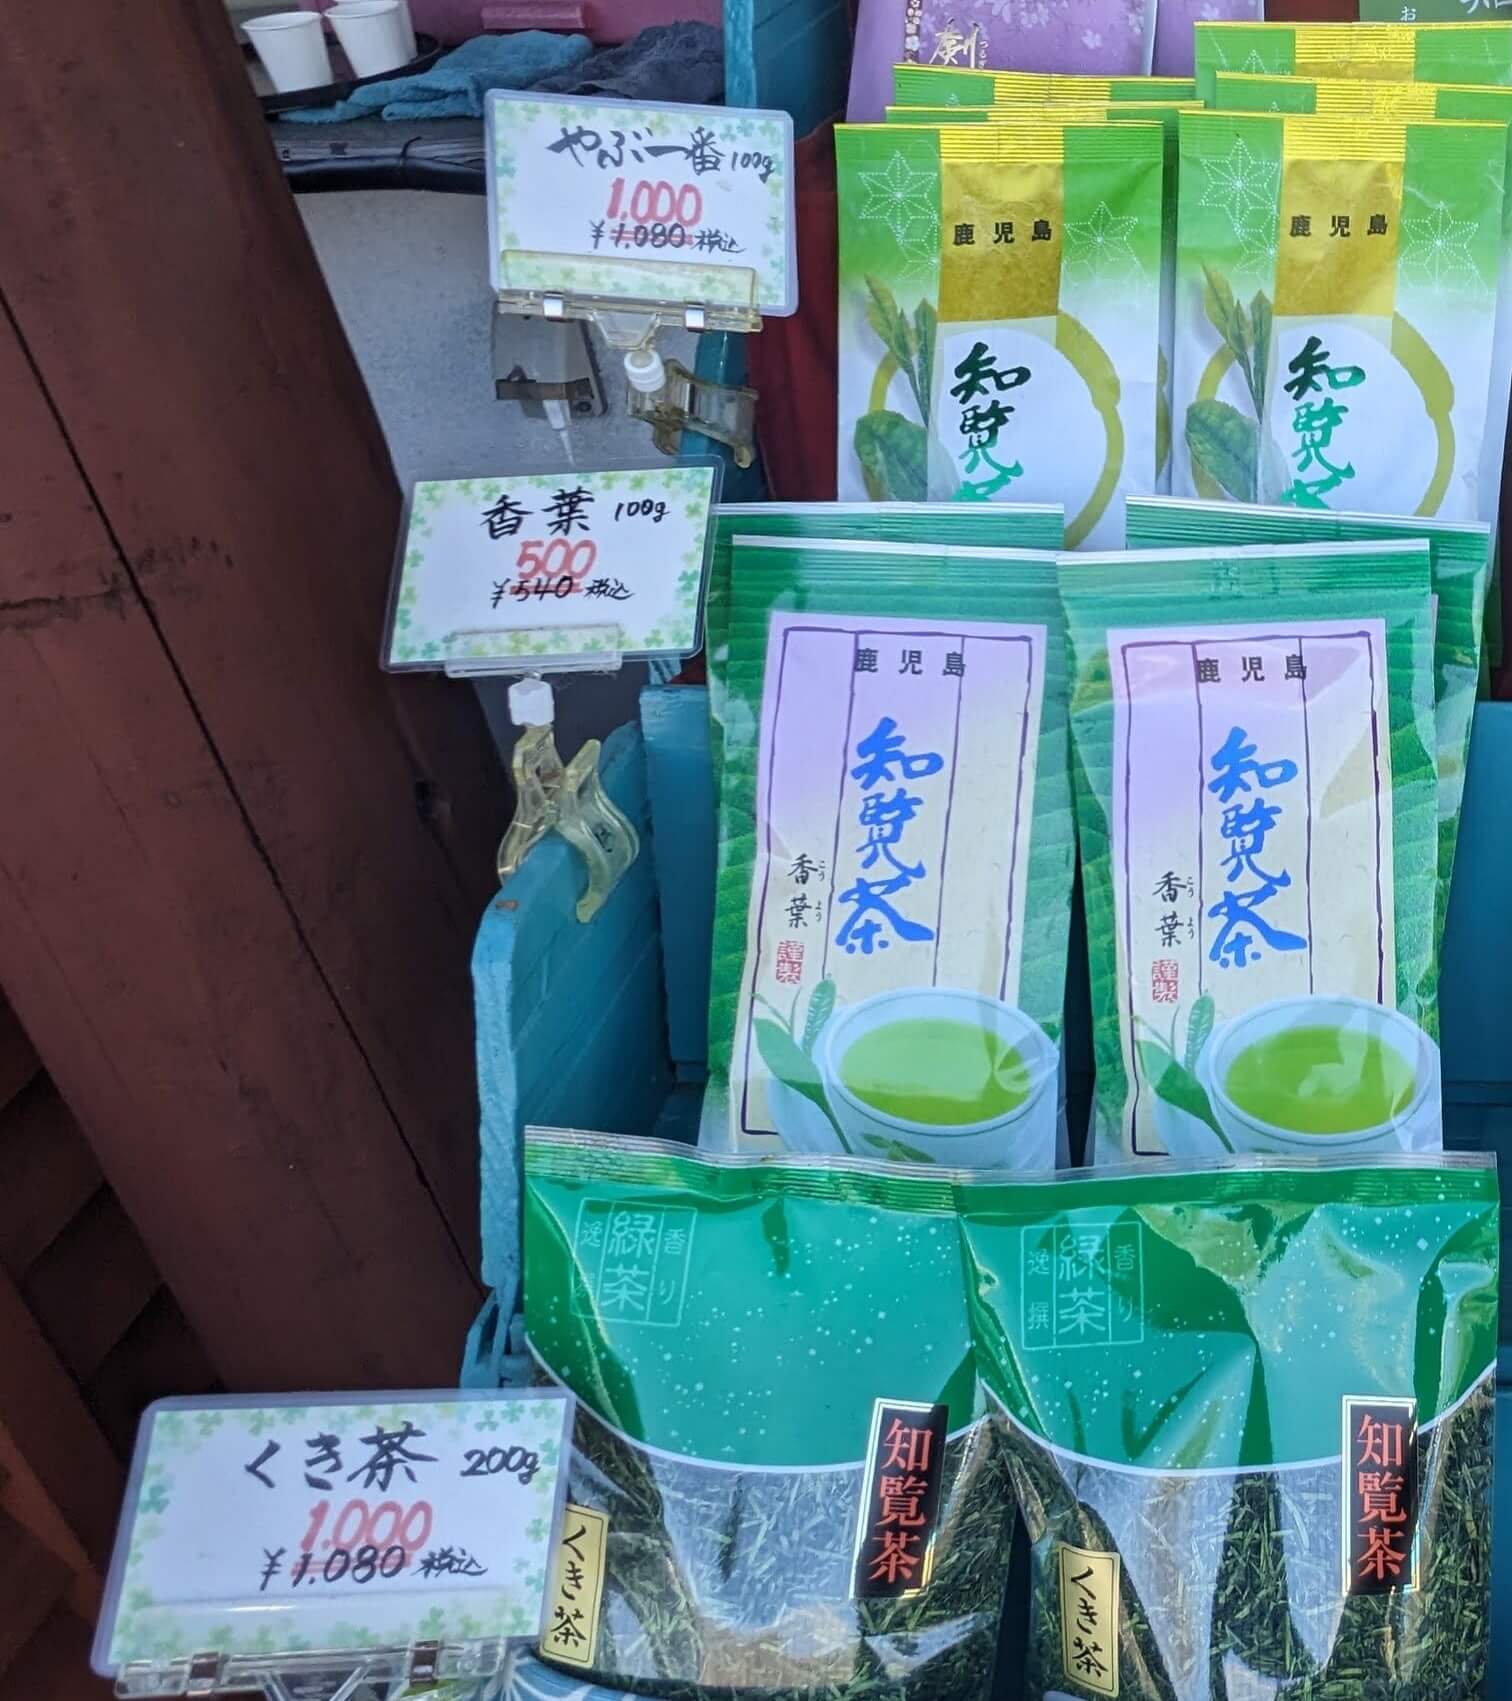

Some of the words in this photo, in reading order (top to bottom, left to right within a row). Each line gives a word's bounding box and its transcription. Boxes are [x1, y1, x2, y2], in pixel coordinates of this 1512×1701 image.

[547, 126, 725, 175] やぶ一番
[731, 151, 774, 183] 100g
[694, 229, 745, 254] 税込
[953, 218, 1053, 246] 鹿児島
[1289, 214, 1389, 239] 鹿児島
[481, 486, 595, 540] 香葉
[614, 499, 670, 522] 100g
[516, 538, 597, 580] 500
[585, 578, 635, 600] 税込
[855, 648, 966, 677] 鹿児島
[1197, 654, 1307, 683] 鹿児島
[836, 717, 944, 954] 知覧茶
[1207, 726, 1308, 968] 知覧茶
[785, 853, 818, 928] 香葉
[1152, 871, 1187, 948] 香葉
[601, 1211, 657, 1312] 緑茶
[660, 1228, 686, 1305] 香り
[1059, 1234, 1105, 1334] 緑茶
[1114, 1244, 1136, 1323] 香り
[244, 1421, 438, 1492] くき茶
[459, 1446, 540, 1485] 200g
[868, 1418, 933, 1585] 知覧茶
[1357, 1413, 1407, 1580] 知覧茶
[411, 1546, 487, 1579] 税込
[550, 1525, 586, 1648] くき茶
[1070, 1567, 1108, 1678] くき茶
